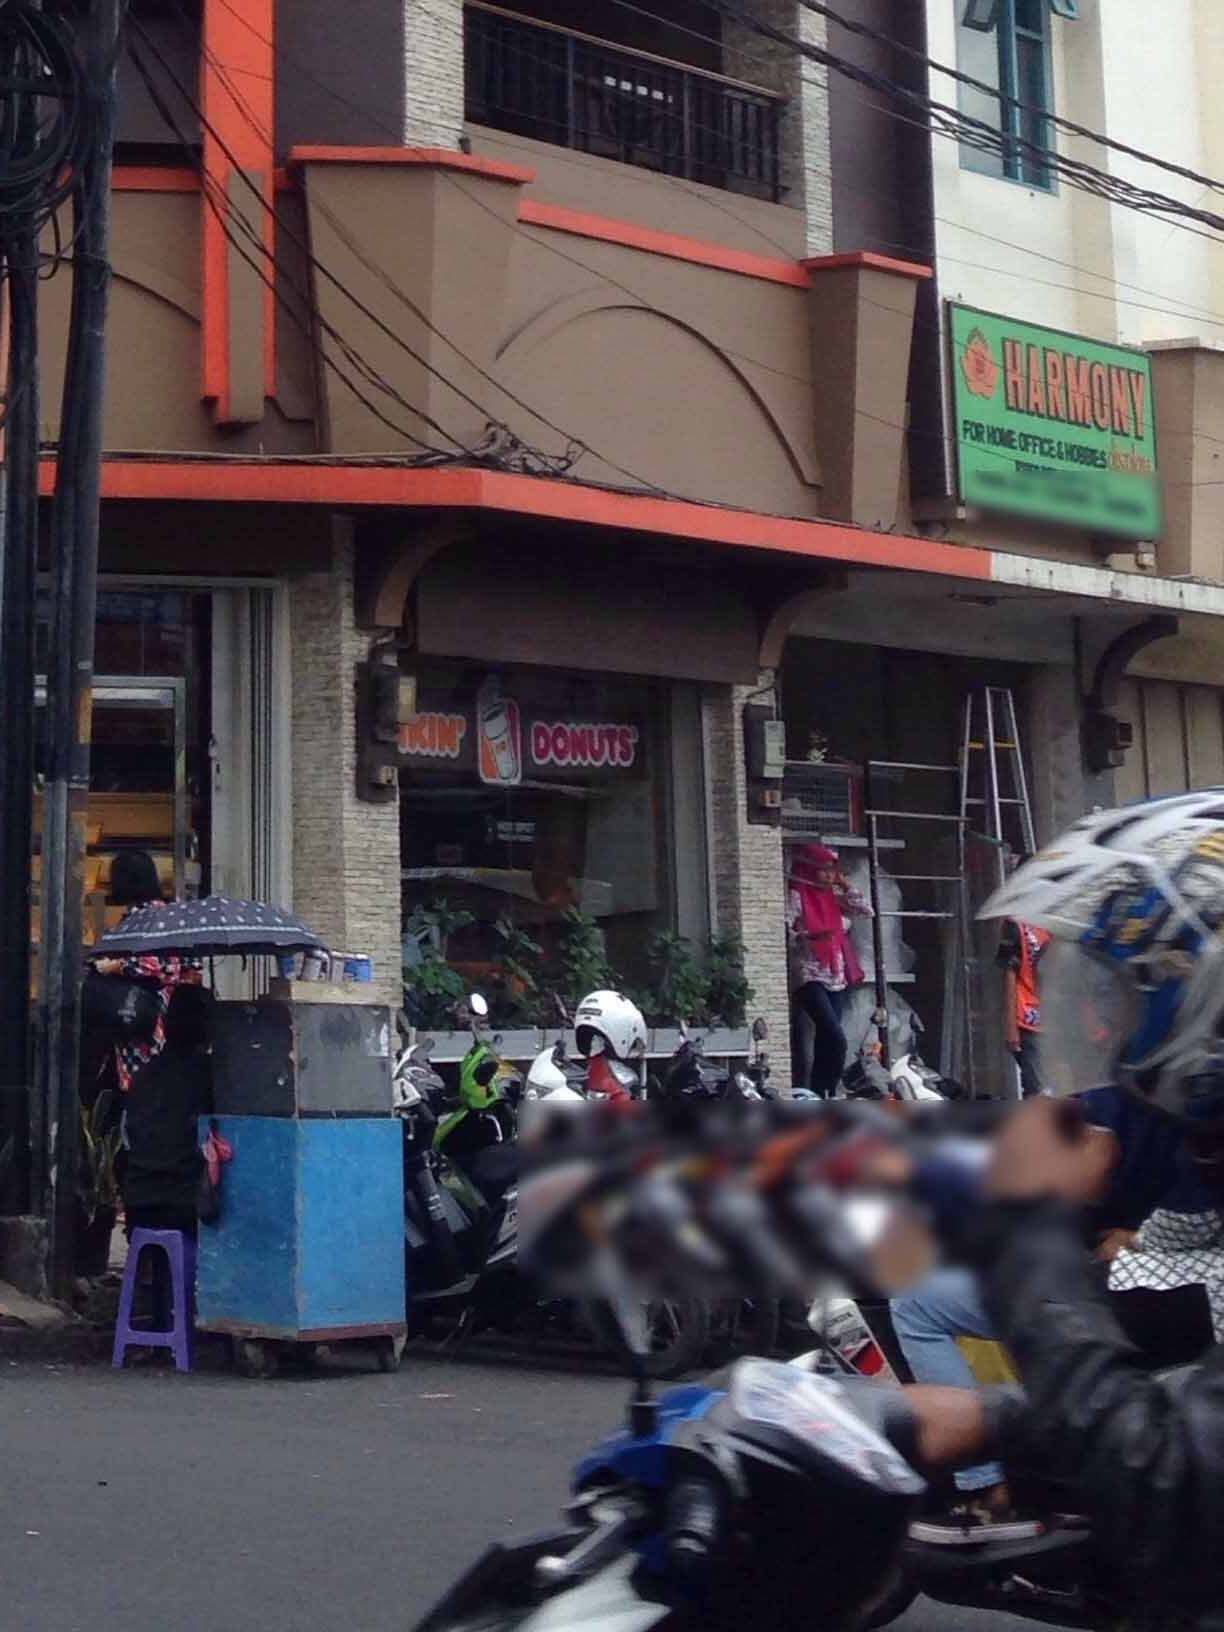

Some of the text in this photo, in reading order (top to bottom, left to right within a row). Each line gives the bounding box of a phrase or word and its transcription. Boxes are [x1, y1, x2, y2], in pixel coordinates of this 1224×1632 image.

[1002, 336, 1145, 441] HARMONY
[962, 420, 986, 442] FOR
[986, 426, 1018, 451] HOME
[1017, 432, 1057, 460] OFFICE
[532, 723, 636, 764] DONUTS
